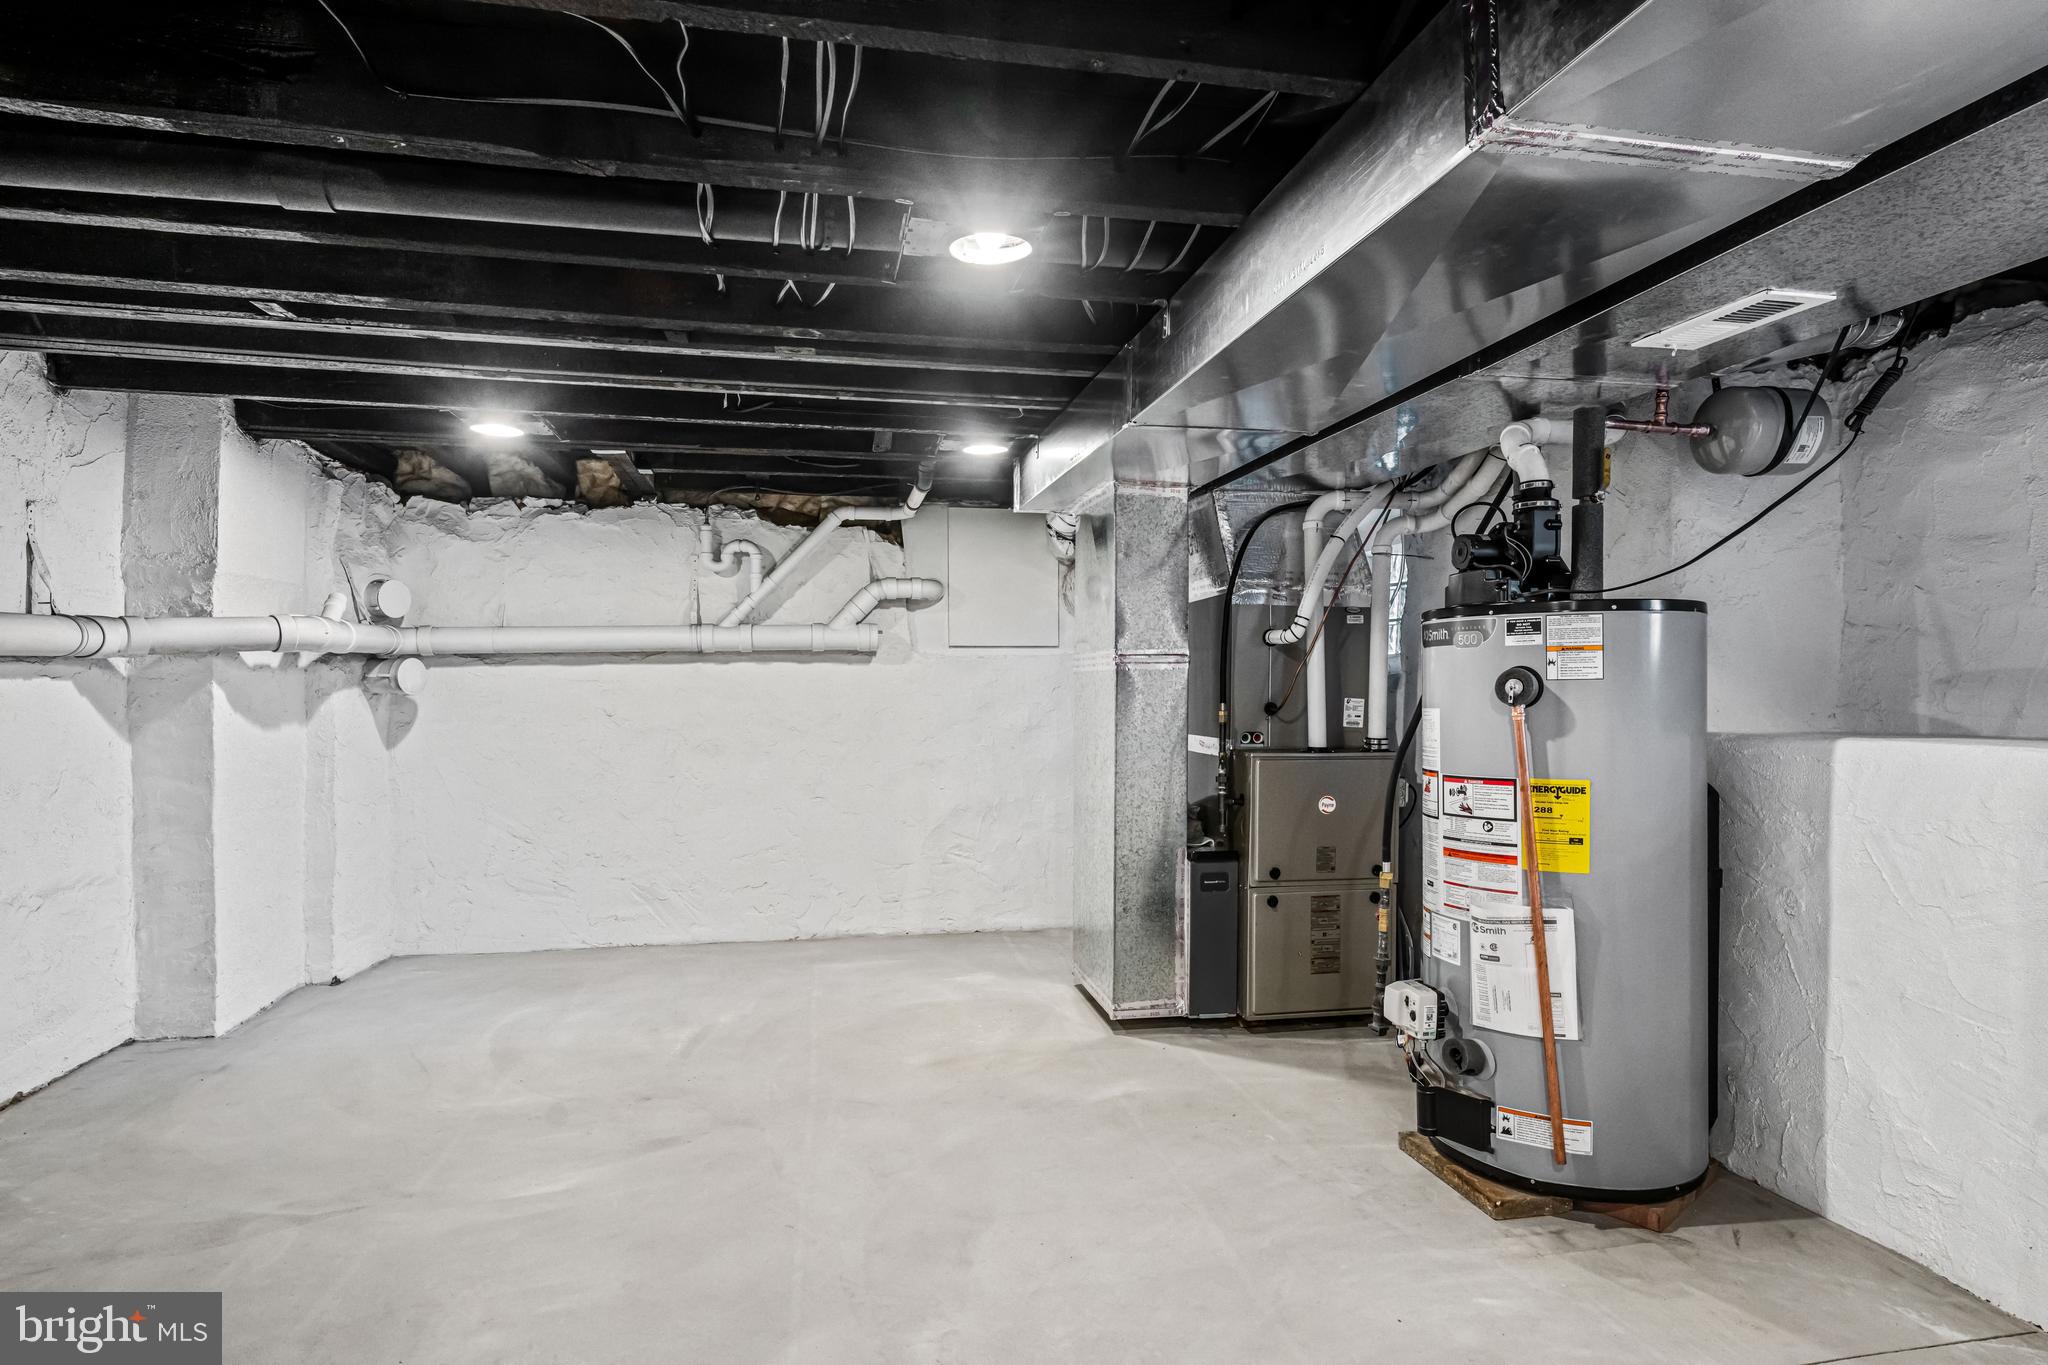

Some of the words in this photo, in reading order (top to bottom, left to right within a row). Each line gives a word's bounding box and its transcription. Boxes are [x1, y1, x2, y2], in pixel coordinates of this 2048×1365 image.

[1457, 633, 1478, 646] 500
[1534, 806, 1553, 814] 288
[1479, 926, 1507, 936] Smith
